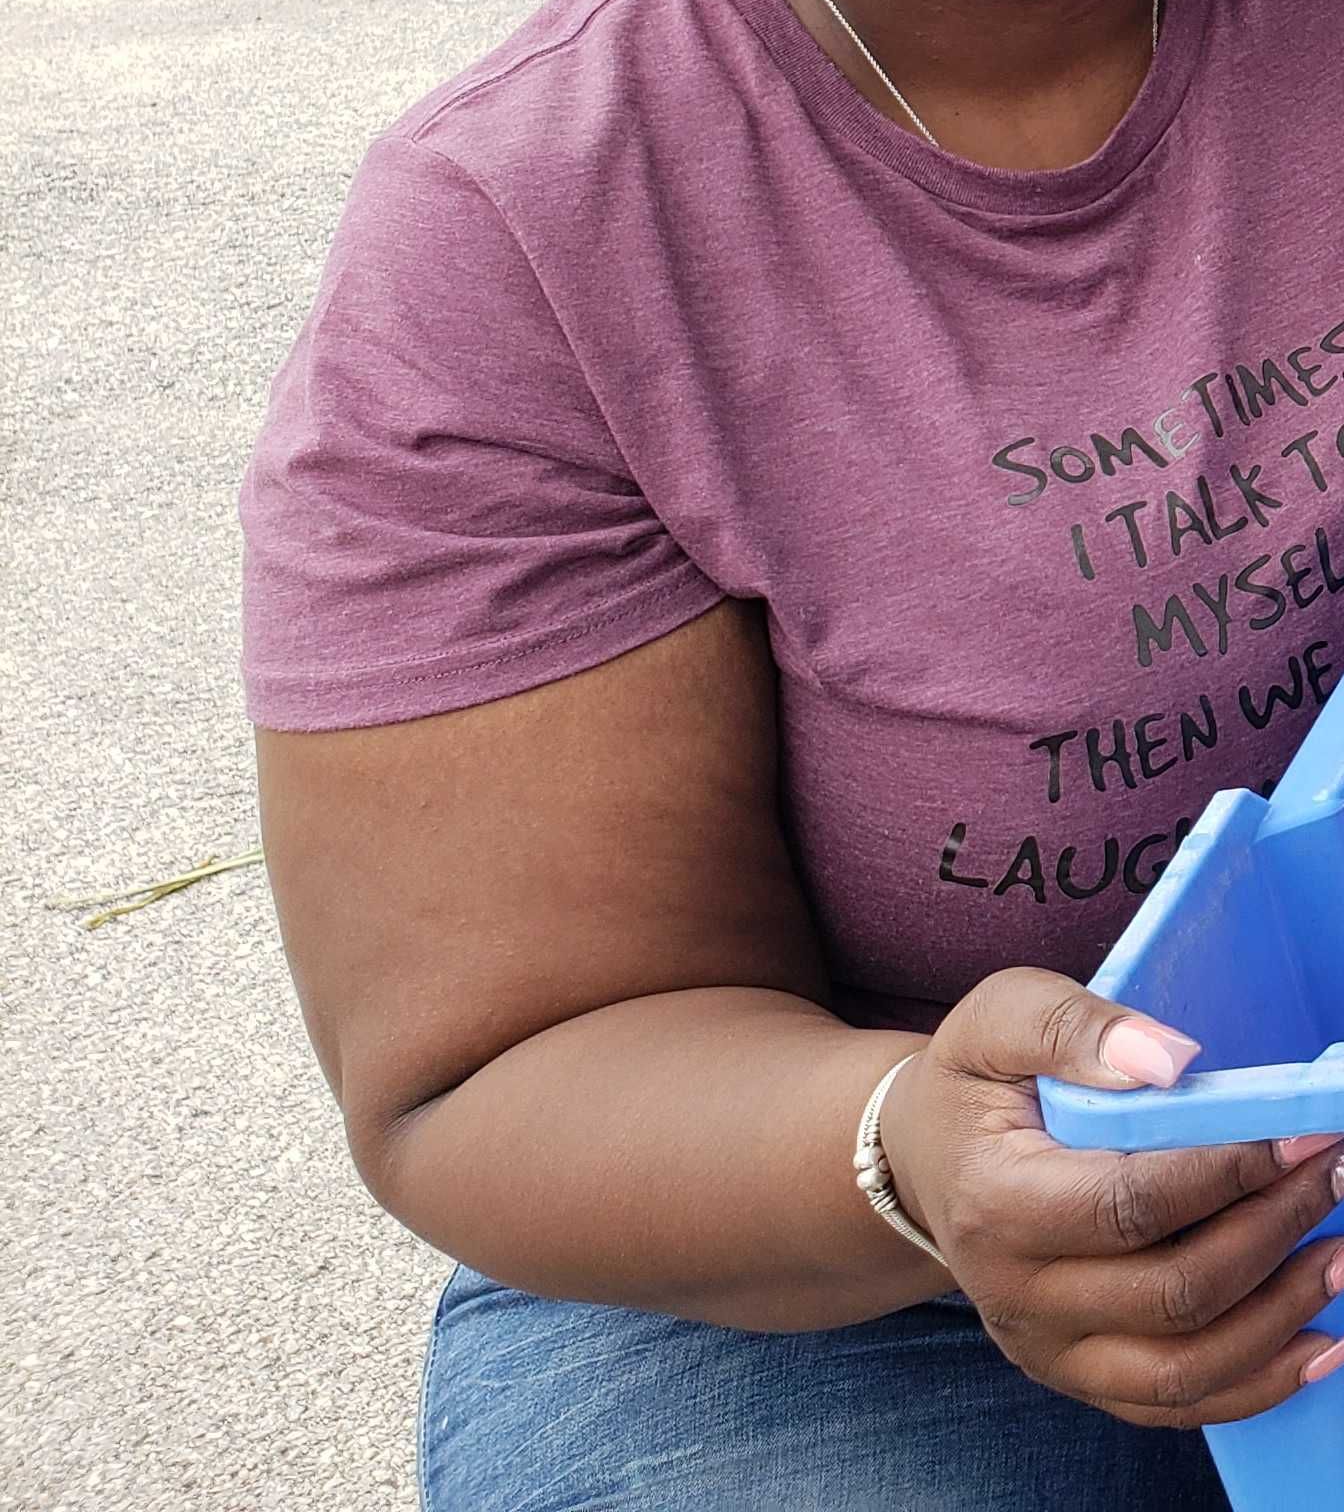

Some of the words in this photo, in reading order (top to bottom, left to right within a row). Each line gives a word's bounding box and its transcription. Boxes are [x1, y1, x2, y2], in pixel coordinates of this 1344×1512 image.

[1070, 523, 1095, 580] I
[1105, 464, 1284, 569] TALK
[1030, 694, 1219, 804] THEN
[1238, 640, 1333, 730] WE
[939, 816, 1192, 904] LAUG
